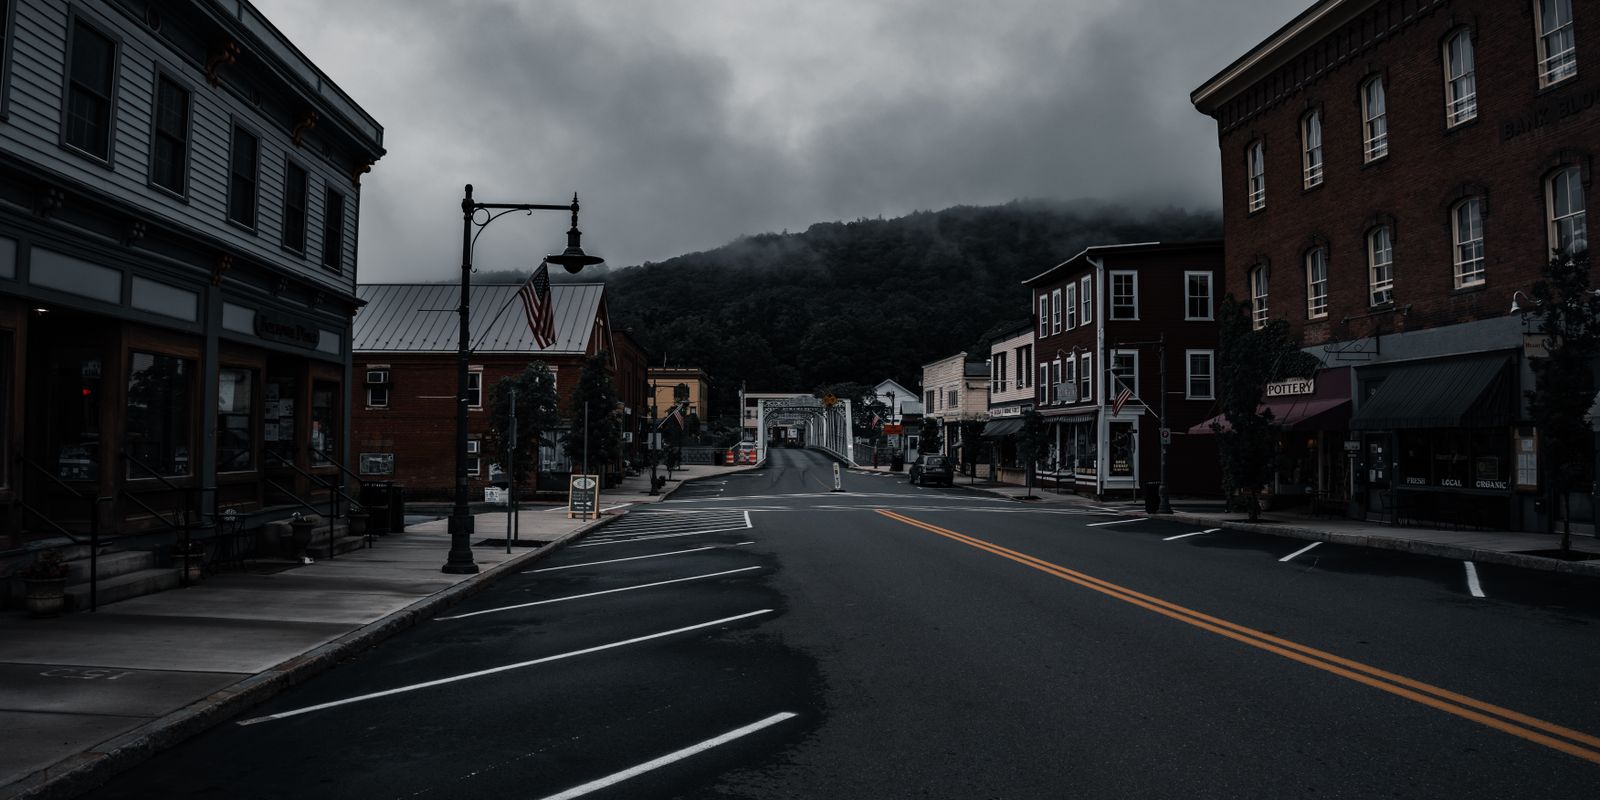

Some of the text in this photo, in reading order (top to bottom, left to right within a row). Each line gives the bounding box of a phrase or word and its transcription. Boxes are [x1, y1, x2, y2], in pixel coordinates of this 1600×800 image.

[1504, 108, 1552, 141] BANK
[1268, 383, 1313, 395] POTTERY
[1406, 477, 1506, 489] FRESH LOCAL ORGANIC
